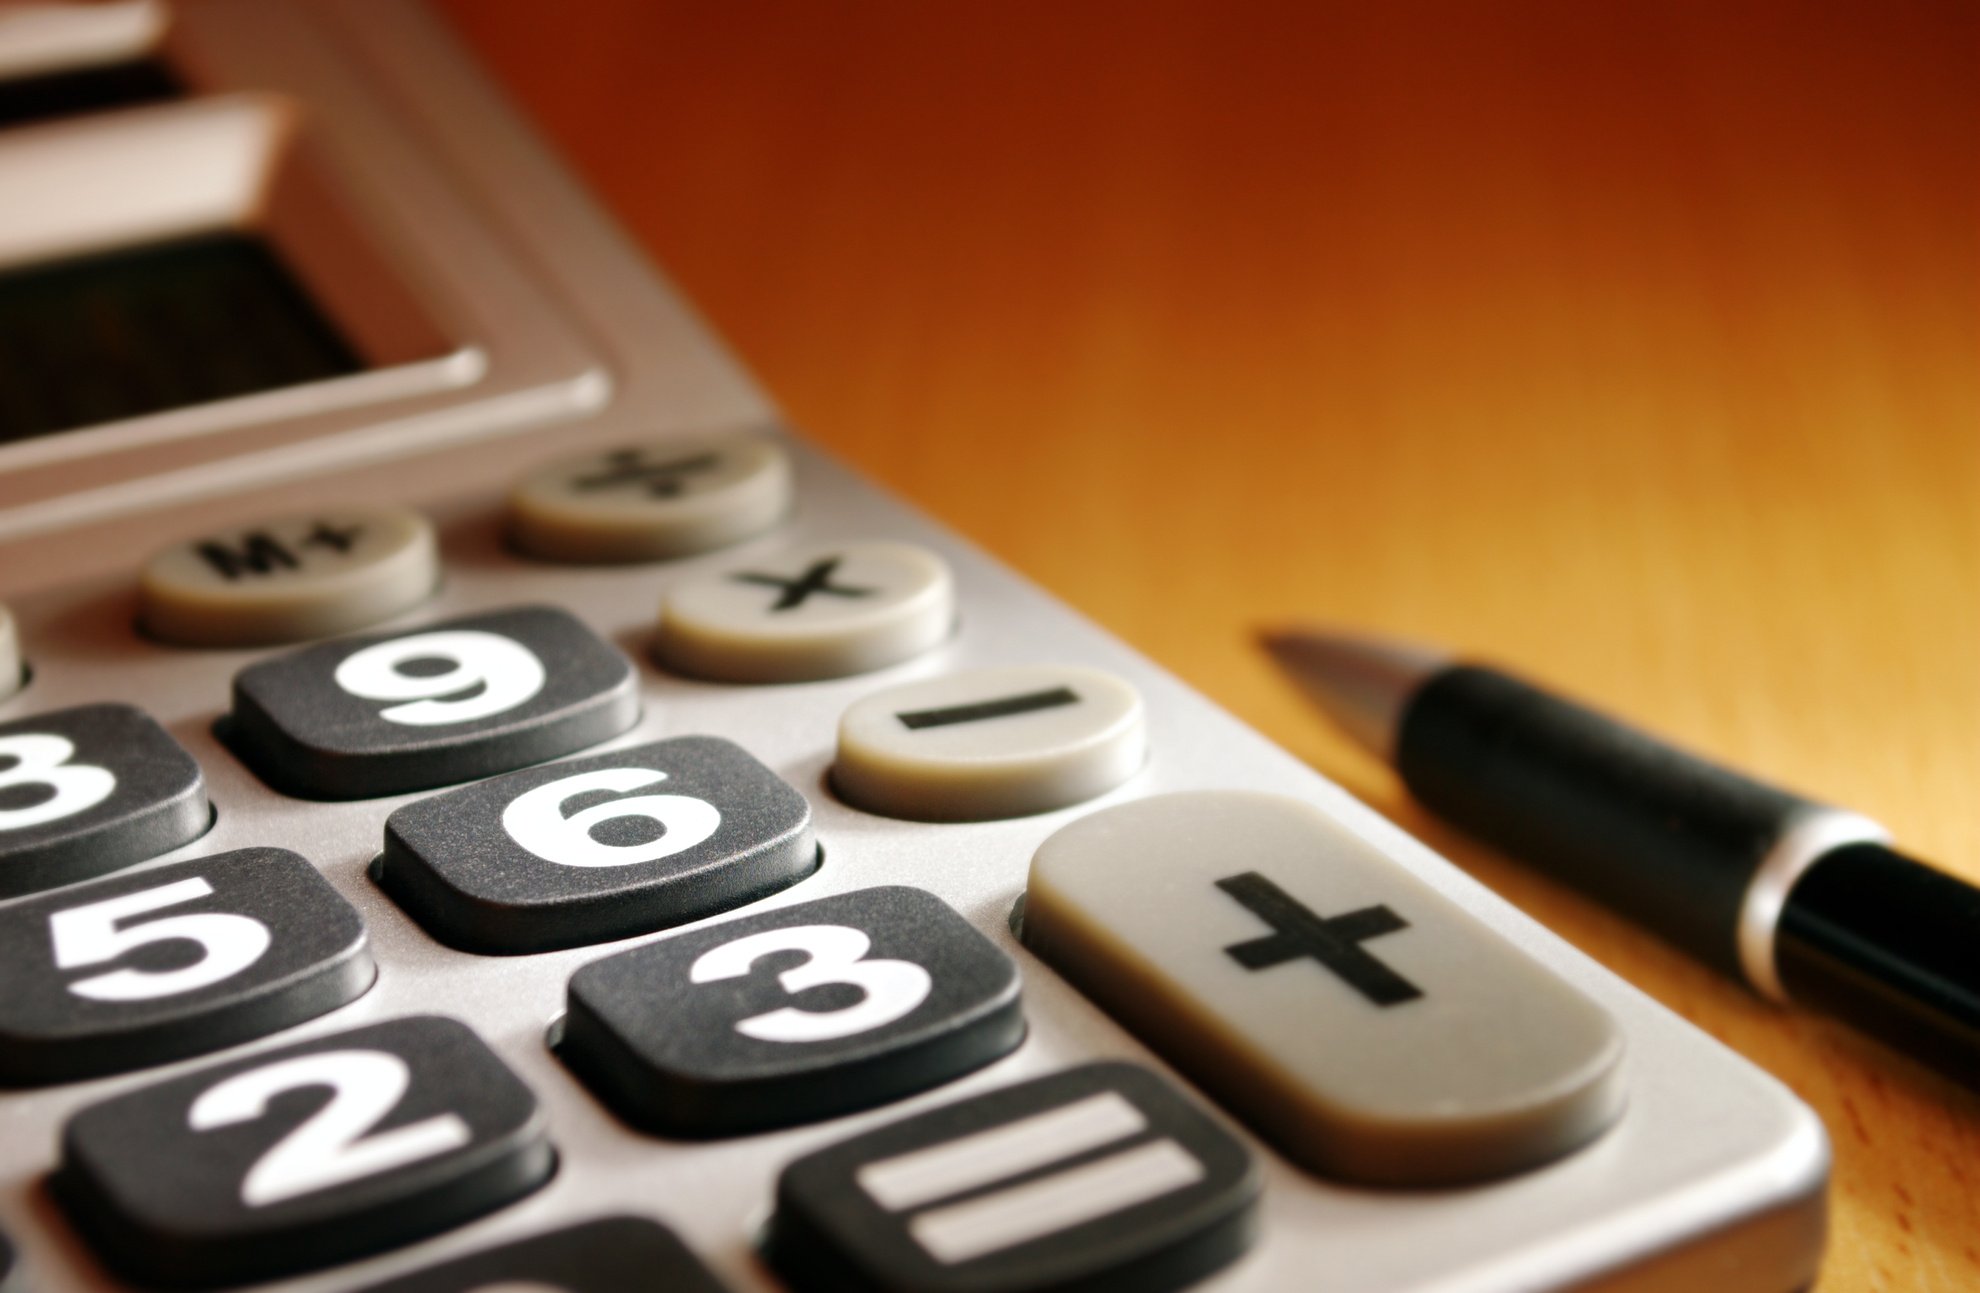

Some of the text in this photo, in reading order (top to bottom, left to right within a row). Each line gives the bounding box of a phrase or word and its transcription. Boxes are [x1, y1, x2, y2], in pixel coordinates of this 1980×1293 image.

[335, 631, 545, 725] 9
[0, 734, 116, 831] 8
[501, 767, 722, 868] 6
[50, 876, 271, 1001] 5
[689, 924, 931, 1042] 3
[189, 1049, 468, 1207] 2
